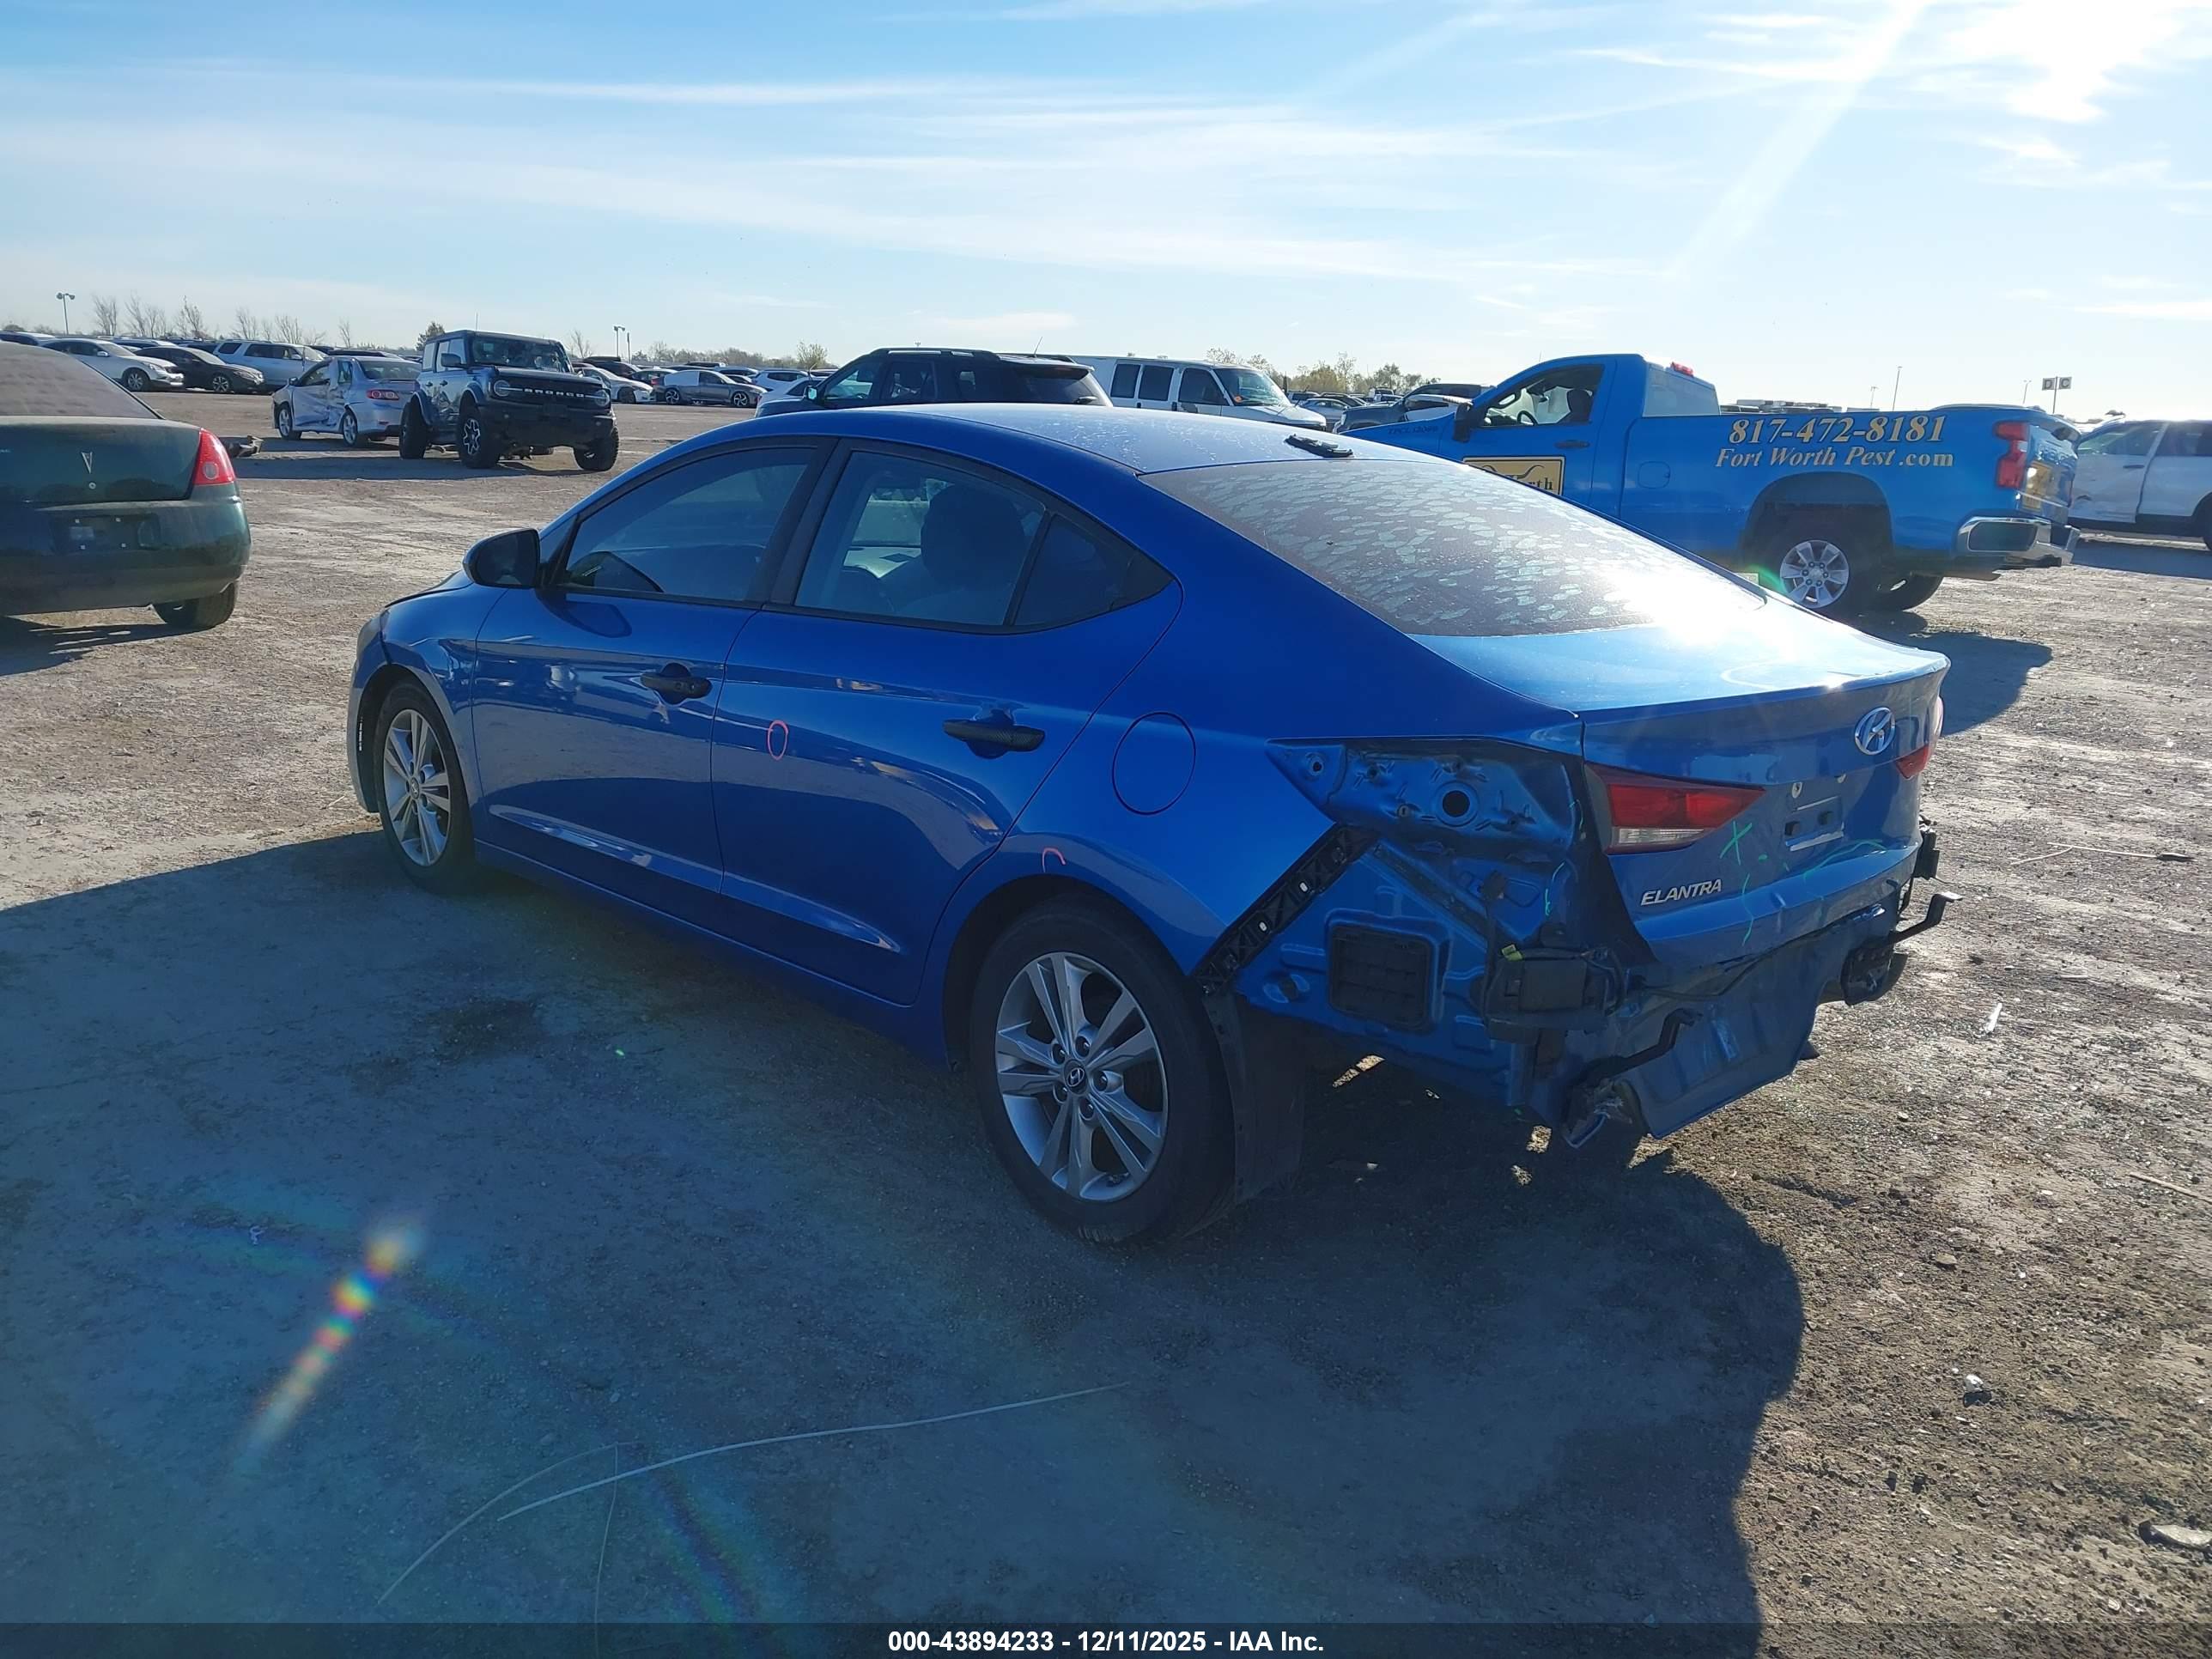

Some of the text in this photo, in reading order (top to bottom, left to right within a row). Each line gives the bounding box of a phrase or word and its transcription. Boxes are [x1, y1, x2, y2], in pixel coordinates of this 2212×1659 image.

[2045, 379, 2053, 390] D
[2060, 378, 2069, 388] C
[525, 388, 584, 398] BRONCO
[1729, 416, 1946, 444] 817-472-8181
[1716, 447, 1762, 468] Fort
[1769, 446, 1836, 466] Worth
[1845, 446, 1896, 465] Pest
[1641, 878, 1722, 906] ELANTRA
